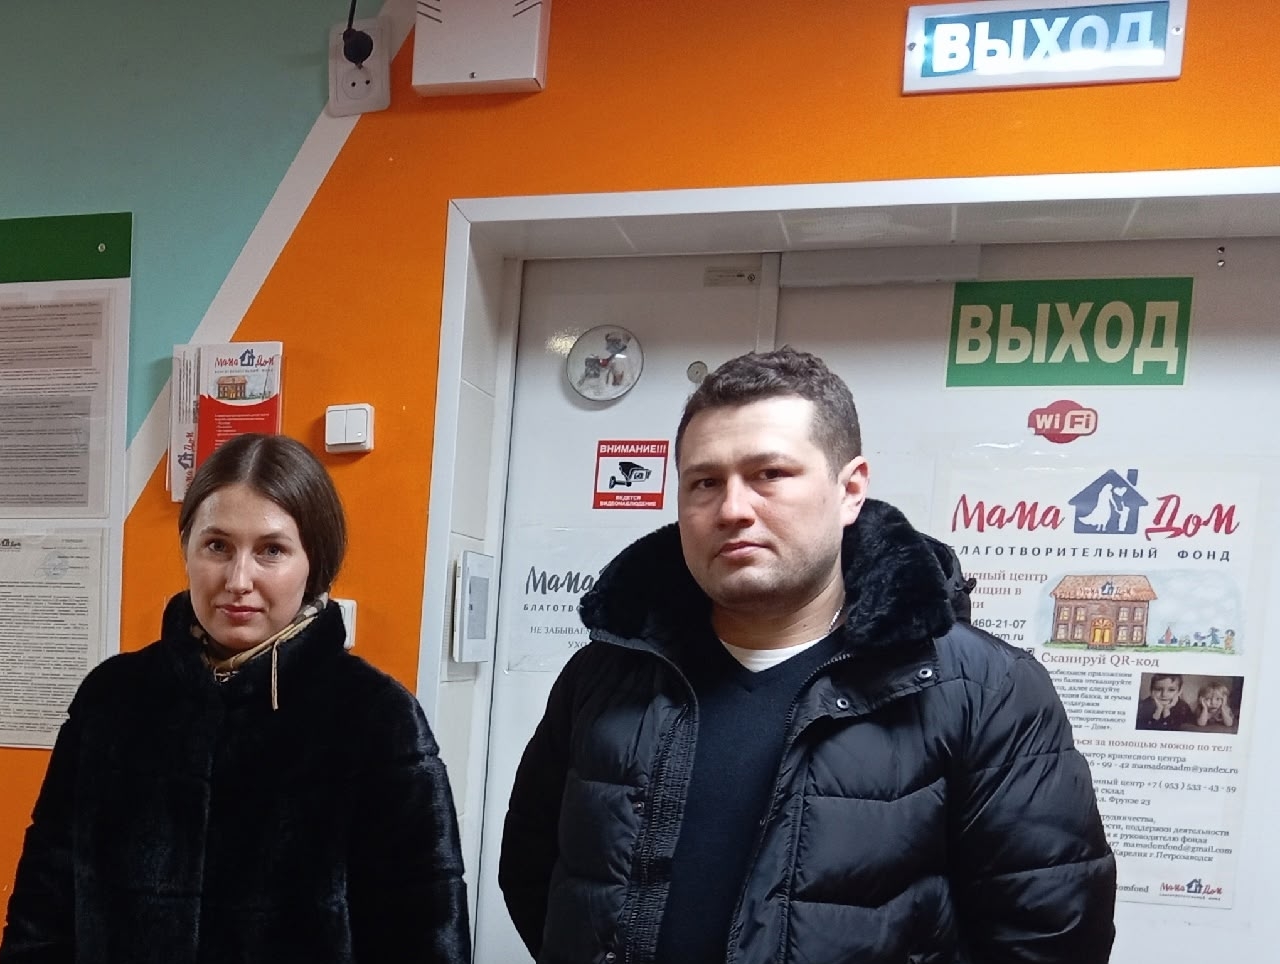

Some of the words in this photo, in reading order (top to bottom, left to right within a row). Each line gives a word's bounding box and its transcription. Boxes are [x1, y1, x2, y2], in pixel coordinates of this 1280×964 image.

[932, 10, 1158, 74] ВЫХОД
[955, 301, 1179, 375] ВЫХОД
[600, 444, 667, 454] ВНИМАНИЕ!!!
[1145, 493, 1240, 541] Дом
[1177, 549, 1231, 562] ФОНД
[1010, 573, 1048, 584] центр
[1041, 652, 1107, 667] Сканируй
[1110, 654, 1160, 668] QR-код
[1160, 742, 1195, 751] можно
